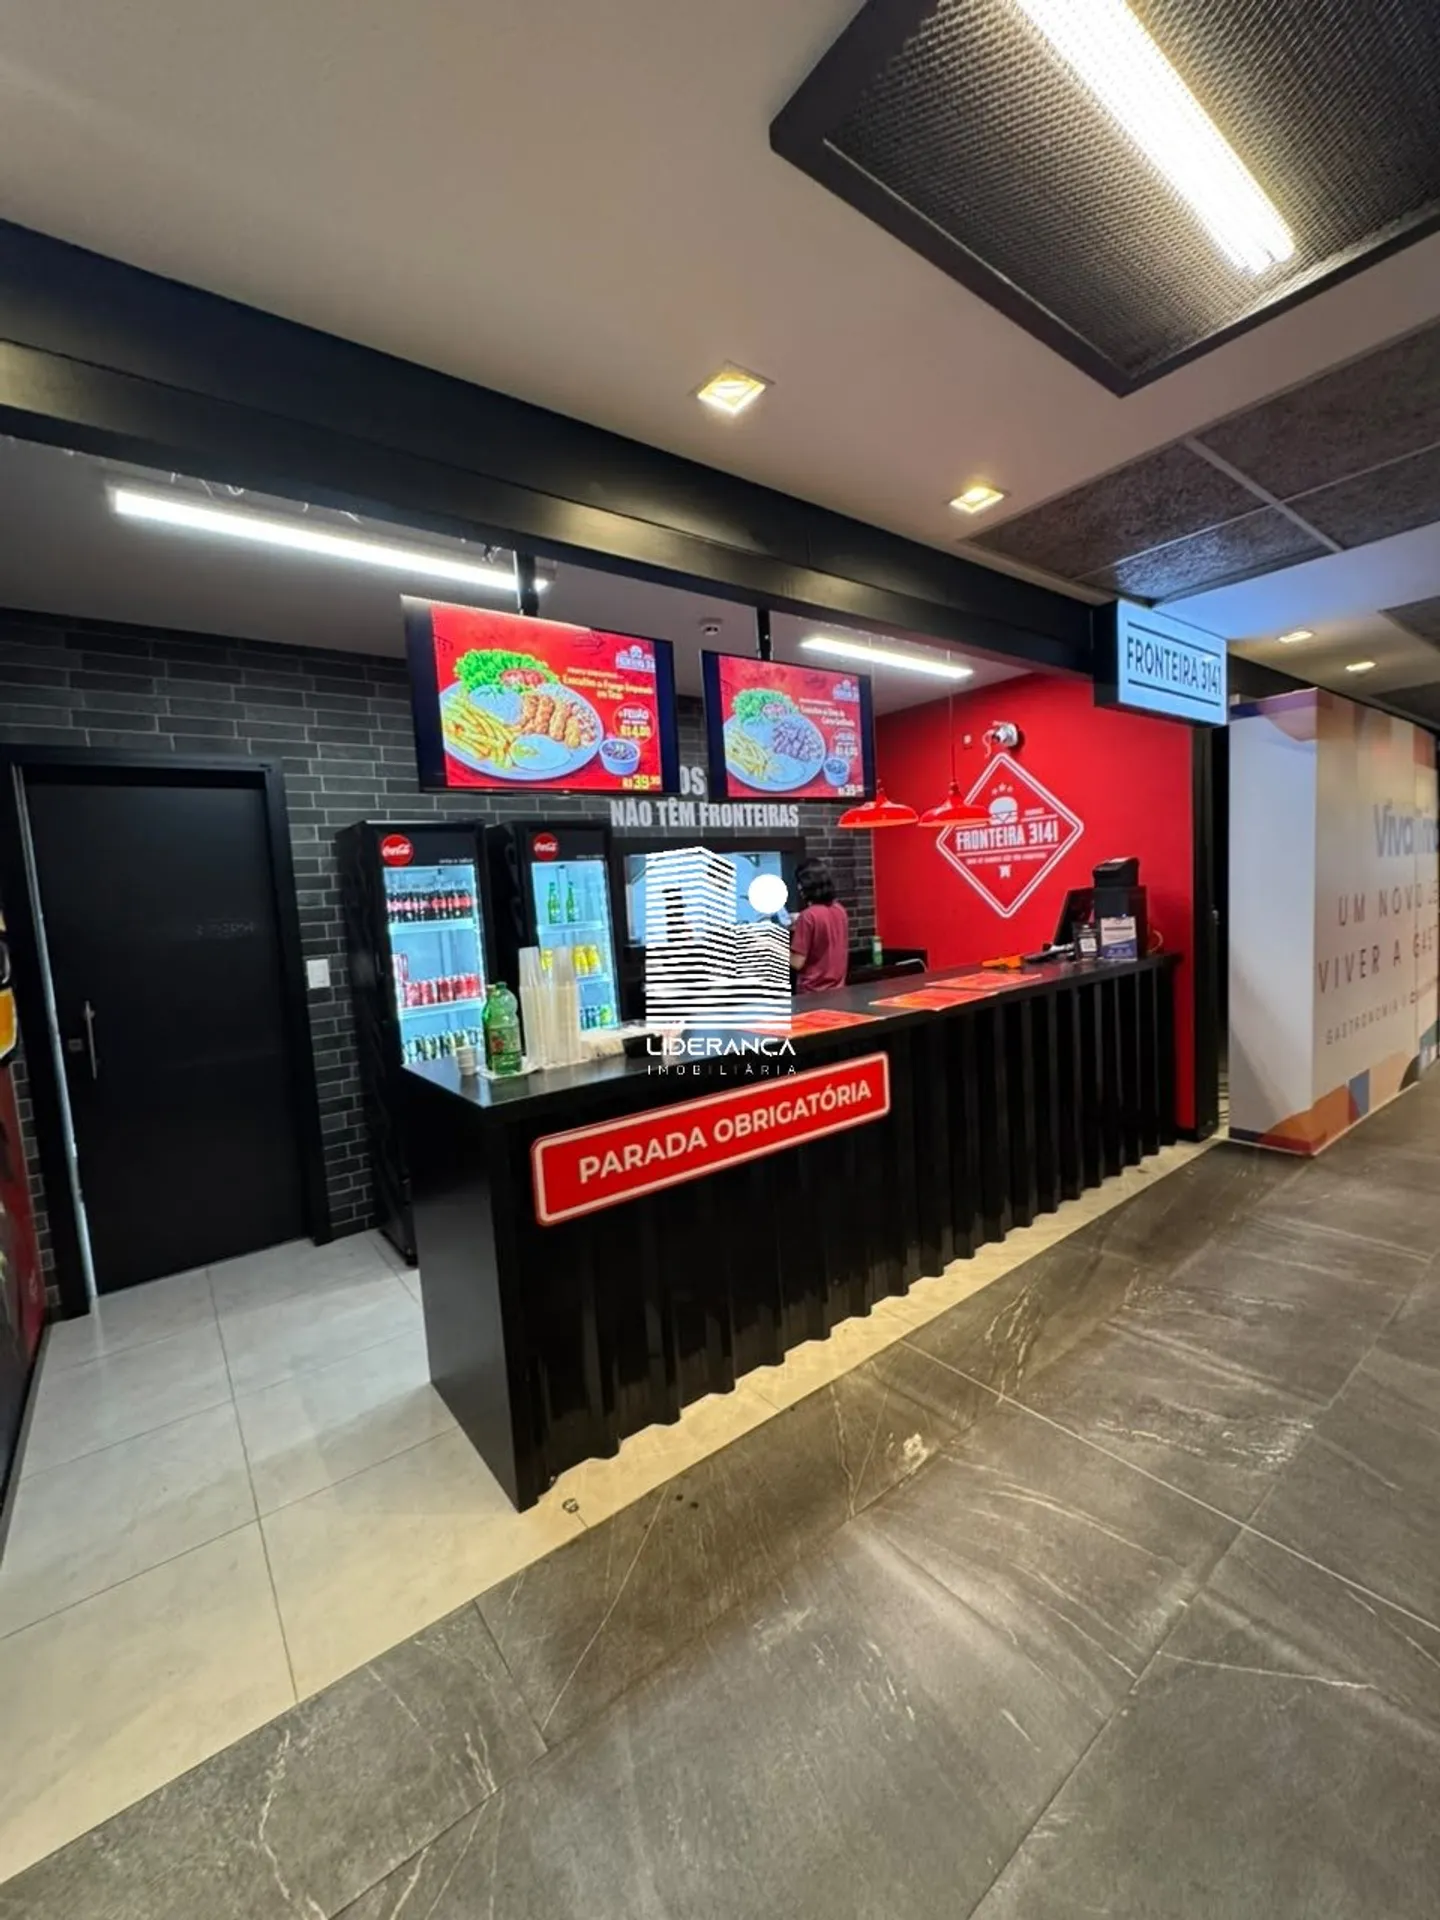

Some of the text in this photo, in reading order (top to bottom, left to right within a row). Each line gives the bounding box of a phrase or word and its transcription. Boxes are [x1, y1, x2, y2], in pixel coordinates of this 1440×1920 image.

[1127, 634, 1222, 696] FRONTEIRA 3141
[610, 797, 799, 827] NÃO TÊM FRONTEIRAS
[956, 820, 1059, 851] FRONTEIRA 3141
[1338, 893, 1366, 927] UM
[1318, 945, 1380, 993] VIVER
[1393, 939, 1402, 967] A
[578, 1077, 873, 1185] PARADA OBRIGATÓRIA
